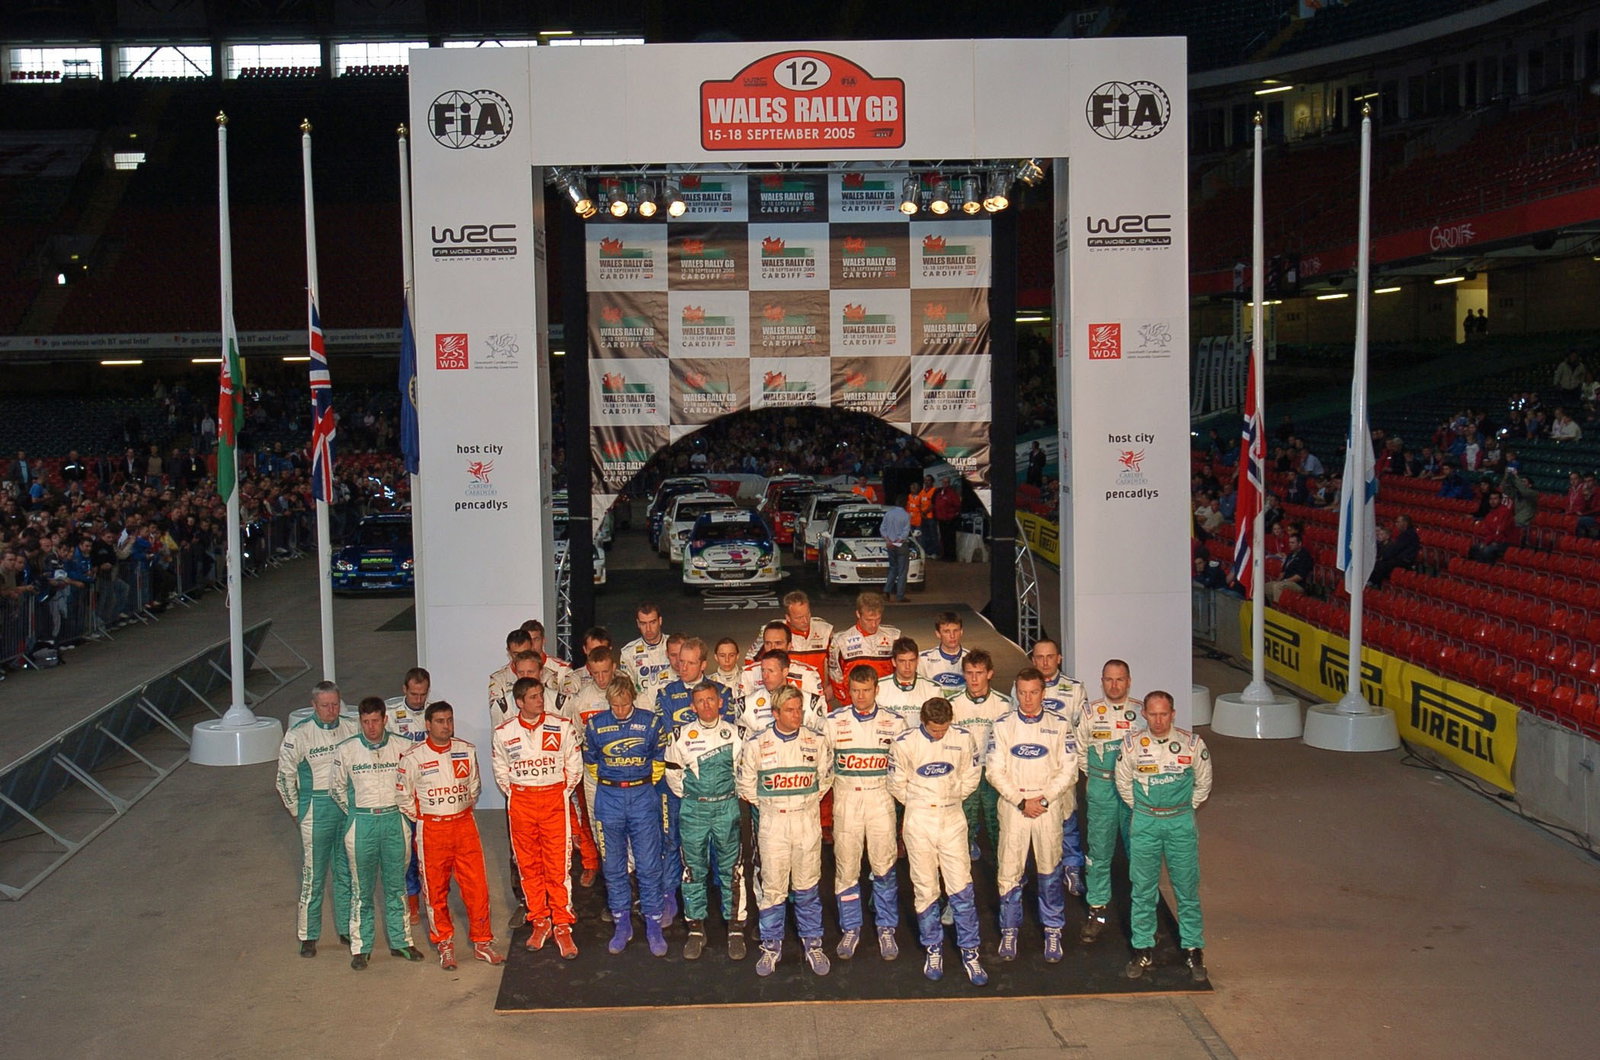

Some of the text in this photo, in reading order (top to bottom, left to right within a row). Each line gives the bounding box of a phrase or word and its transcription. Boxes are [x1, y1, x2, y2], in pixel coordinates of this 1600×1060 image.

[786, 61, 818, 85] 12
[708, 96, 898, 124] WALES RALLY GB
[708, 128, 855, 140] 15-18 SEPTEMBER 2005
[1087, 215, 1171, 233] WRC
[431, 224, 516, 243] WRC
[1092, 350, 1118, 358] WDA
[440, 360, 465, 368] WDA
[1108, 433, 1154, 444] host city
[456, 444, 503, 455] host city
[1105, 488, 1159, 500] pencadlys
[455, 500, 508, 511] pencadlys
[1250, 618, 1300, 672] PRELLI
[1320, 644, 1384, 706] PIRLI
[1411, 680, 1497, 764] PIRELLI
[310, 746, 330, 755] Eddie
[847, 755, 889, 769] Castrol
[516, 766, 556, 777] SPORT
[774, 774, 813, 789] Castrol
[429, 794, 467, 806] SPORT
